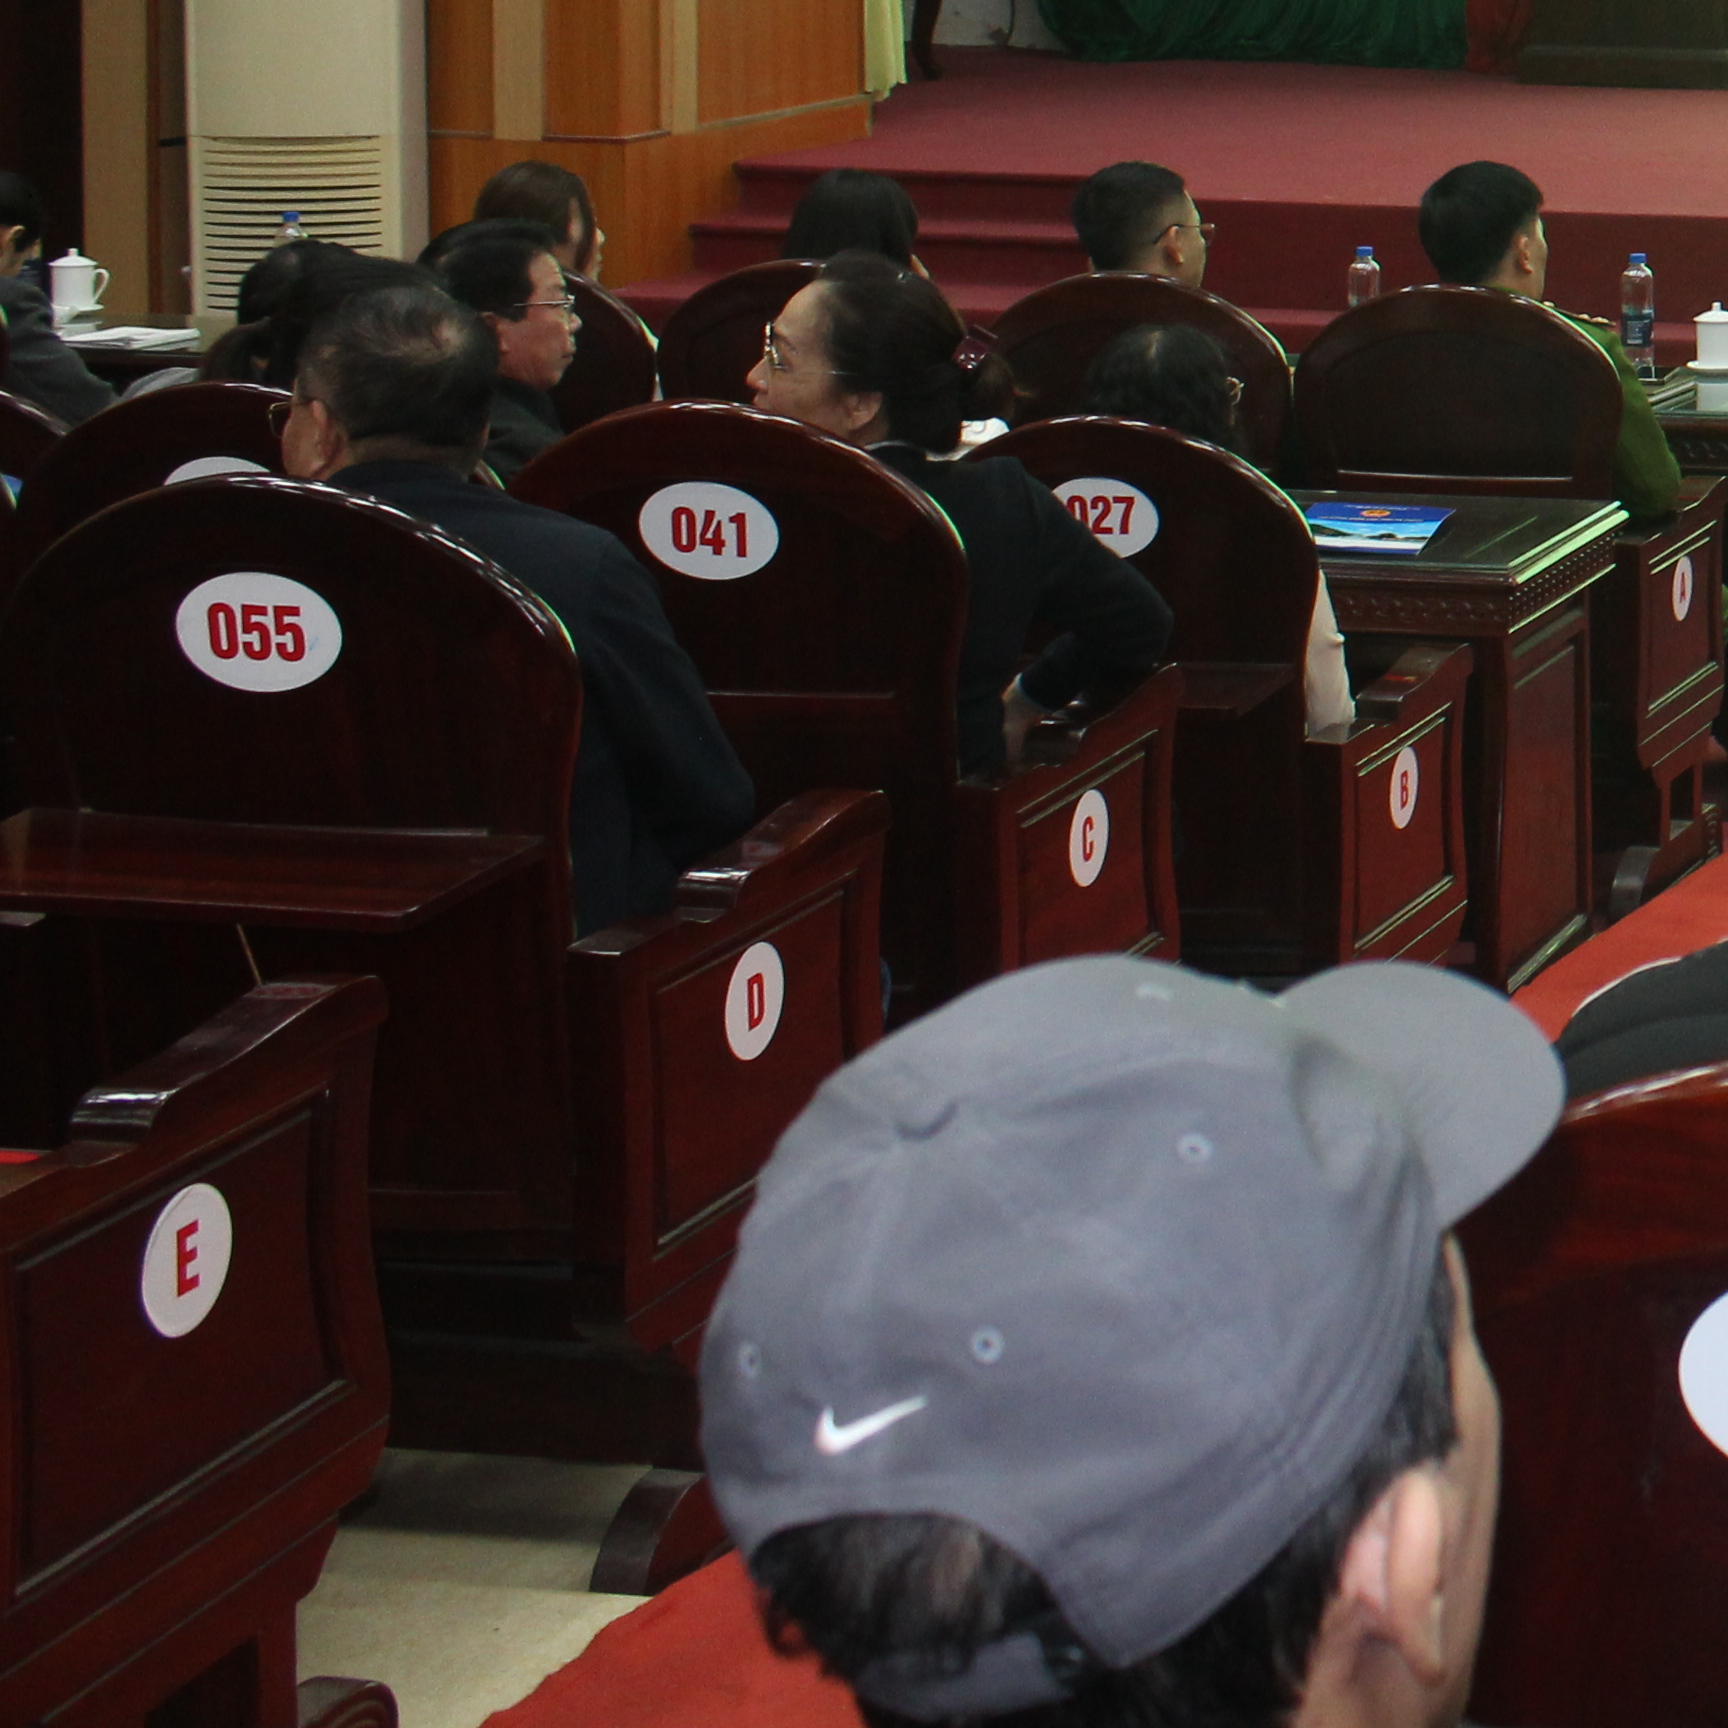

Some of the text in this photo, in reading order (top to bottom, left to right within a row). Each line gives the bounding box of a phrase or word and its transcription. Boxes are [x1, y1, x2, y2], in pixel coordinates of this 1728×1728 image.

[673, 507, 748, 557] 041
[1679, 571, 1687, 605] A
[208, 603, 305, 661] 055
[1400, 770, 1409, 810] B
[1082, 815, 1094, 862] C
[748, 973, 765, 1029] D
[177, 1221, 199, 1296] E
